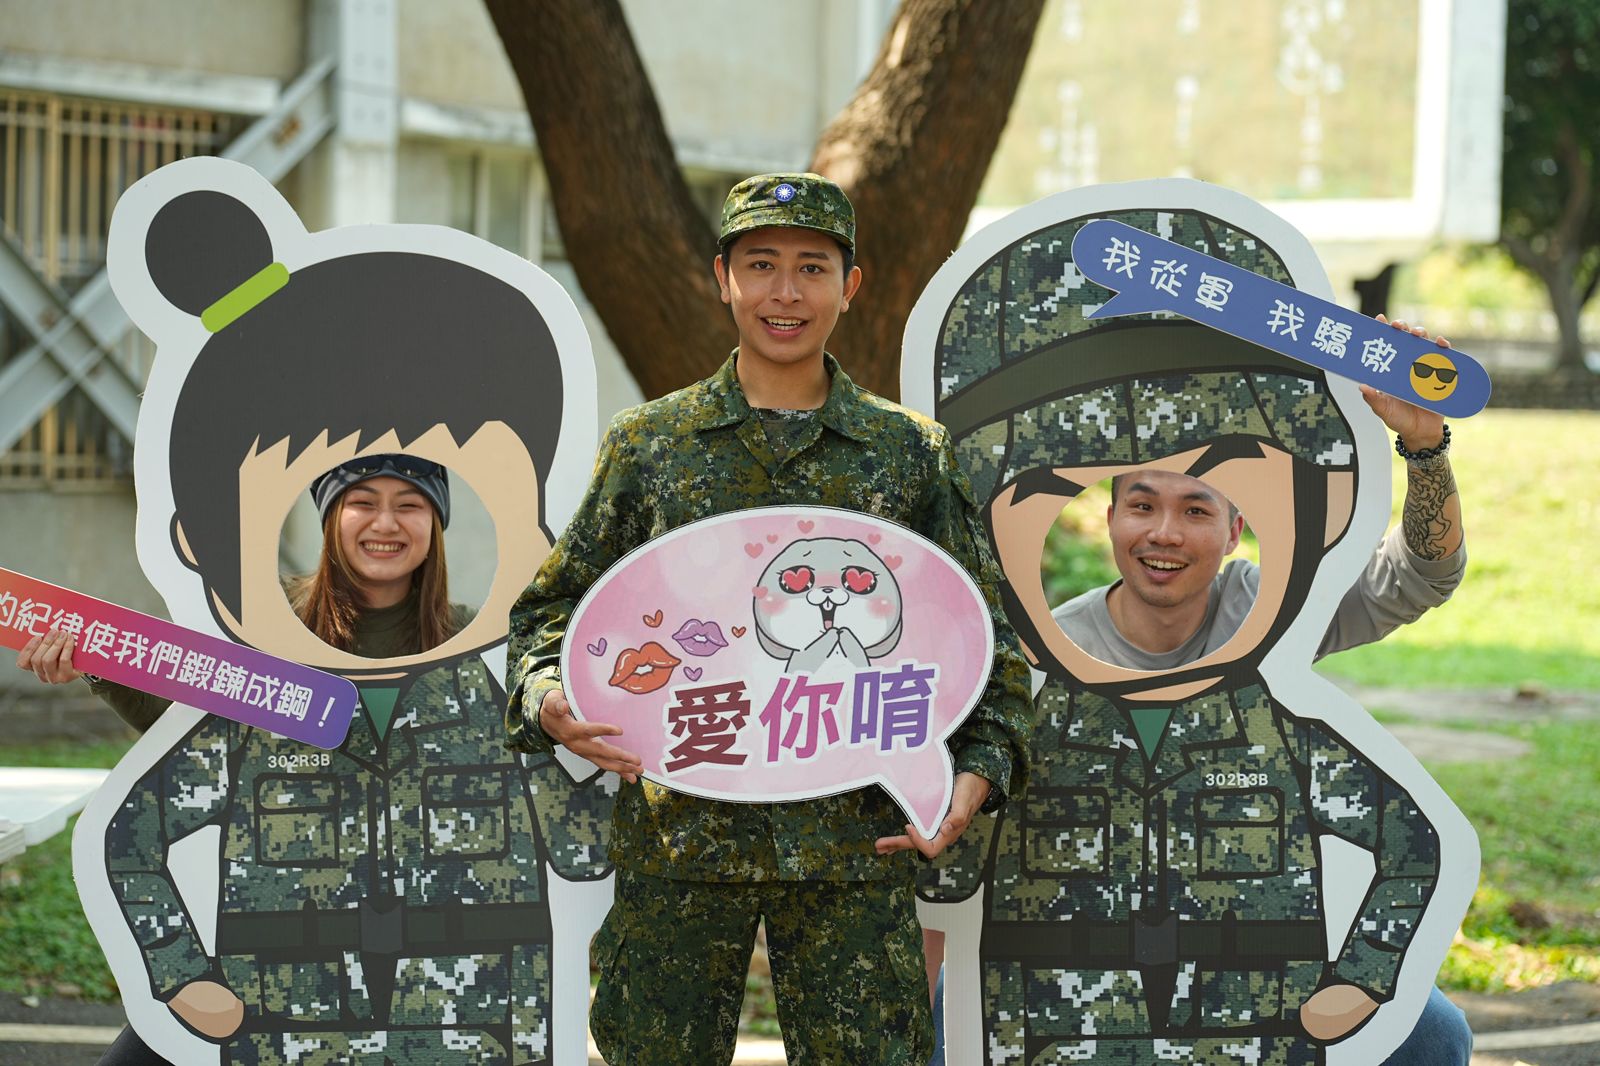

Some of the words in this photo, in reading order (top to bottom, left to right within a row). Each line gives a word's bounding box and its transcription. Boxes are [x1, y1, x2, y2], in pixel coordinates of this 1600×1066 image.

[1102, 237, 1233, 311] 我從軍
[1267, 299, 1397, 373] 我驕傲
[664, 664, 935, 773] 愛你唷
[268, 754, 331, 769] 302R3B
[1205, 773, 1268, 787] 302R3B
